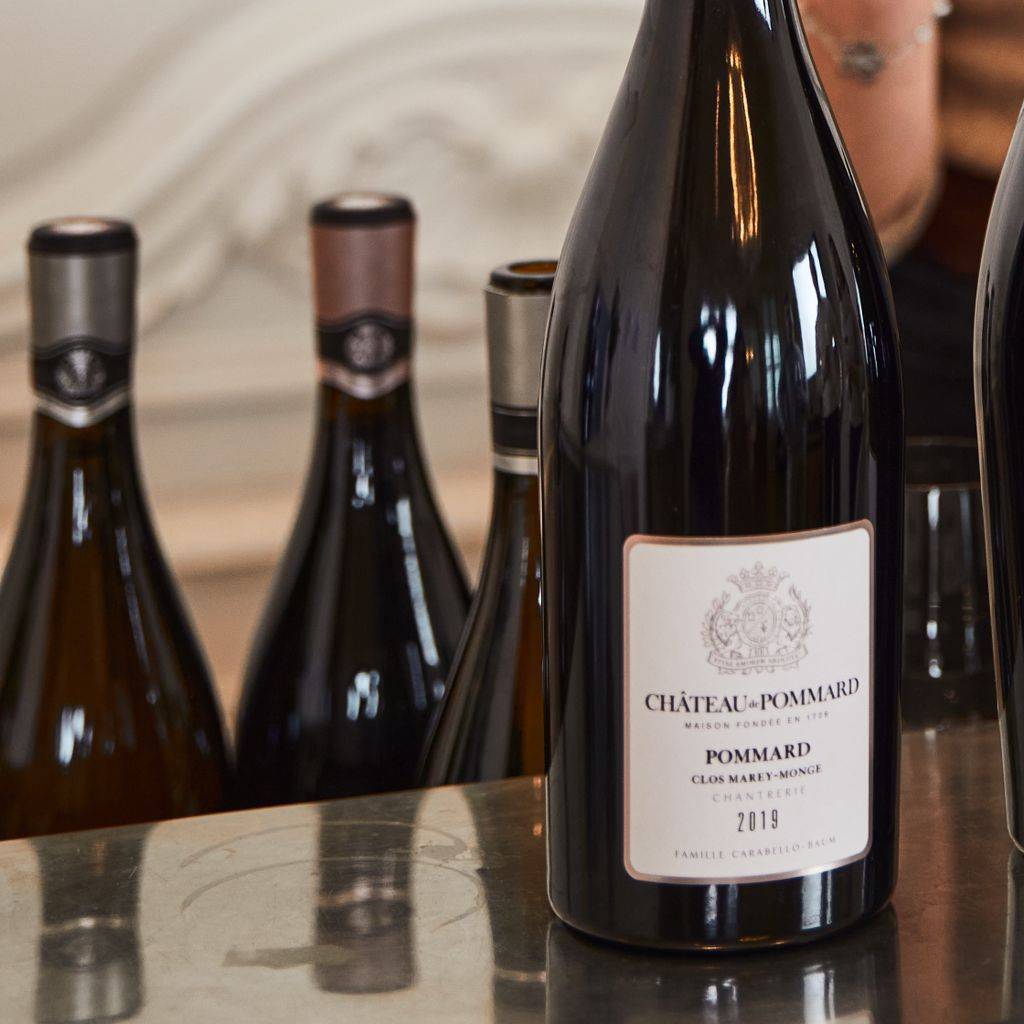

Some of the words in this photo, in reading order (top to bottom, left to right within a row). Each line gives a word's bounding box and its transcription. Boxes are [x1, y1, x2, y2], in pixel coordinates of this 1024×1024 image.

[645, 691, 747, 713] CHÂTEAU
[760, 677, 860, 710] POMMARD
[685, 721, 730, 730] MAISON
[787, 715, 800, 724] EN
[705, 742, 811, 764] POMMARD
[691, 774, 724, 784] CLOS
[729, 764, 822, 783] MAREY-MONGE
[712, 786, 806, 802] CHANTRERIE
[737, 809, 778, 832] 2019
[675, 848, 724, 859] FAMILLE
